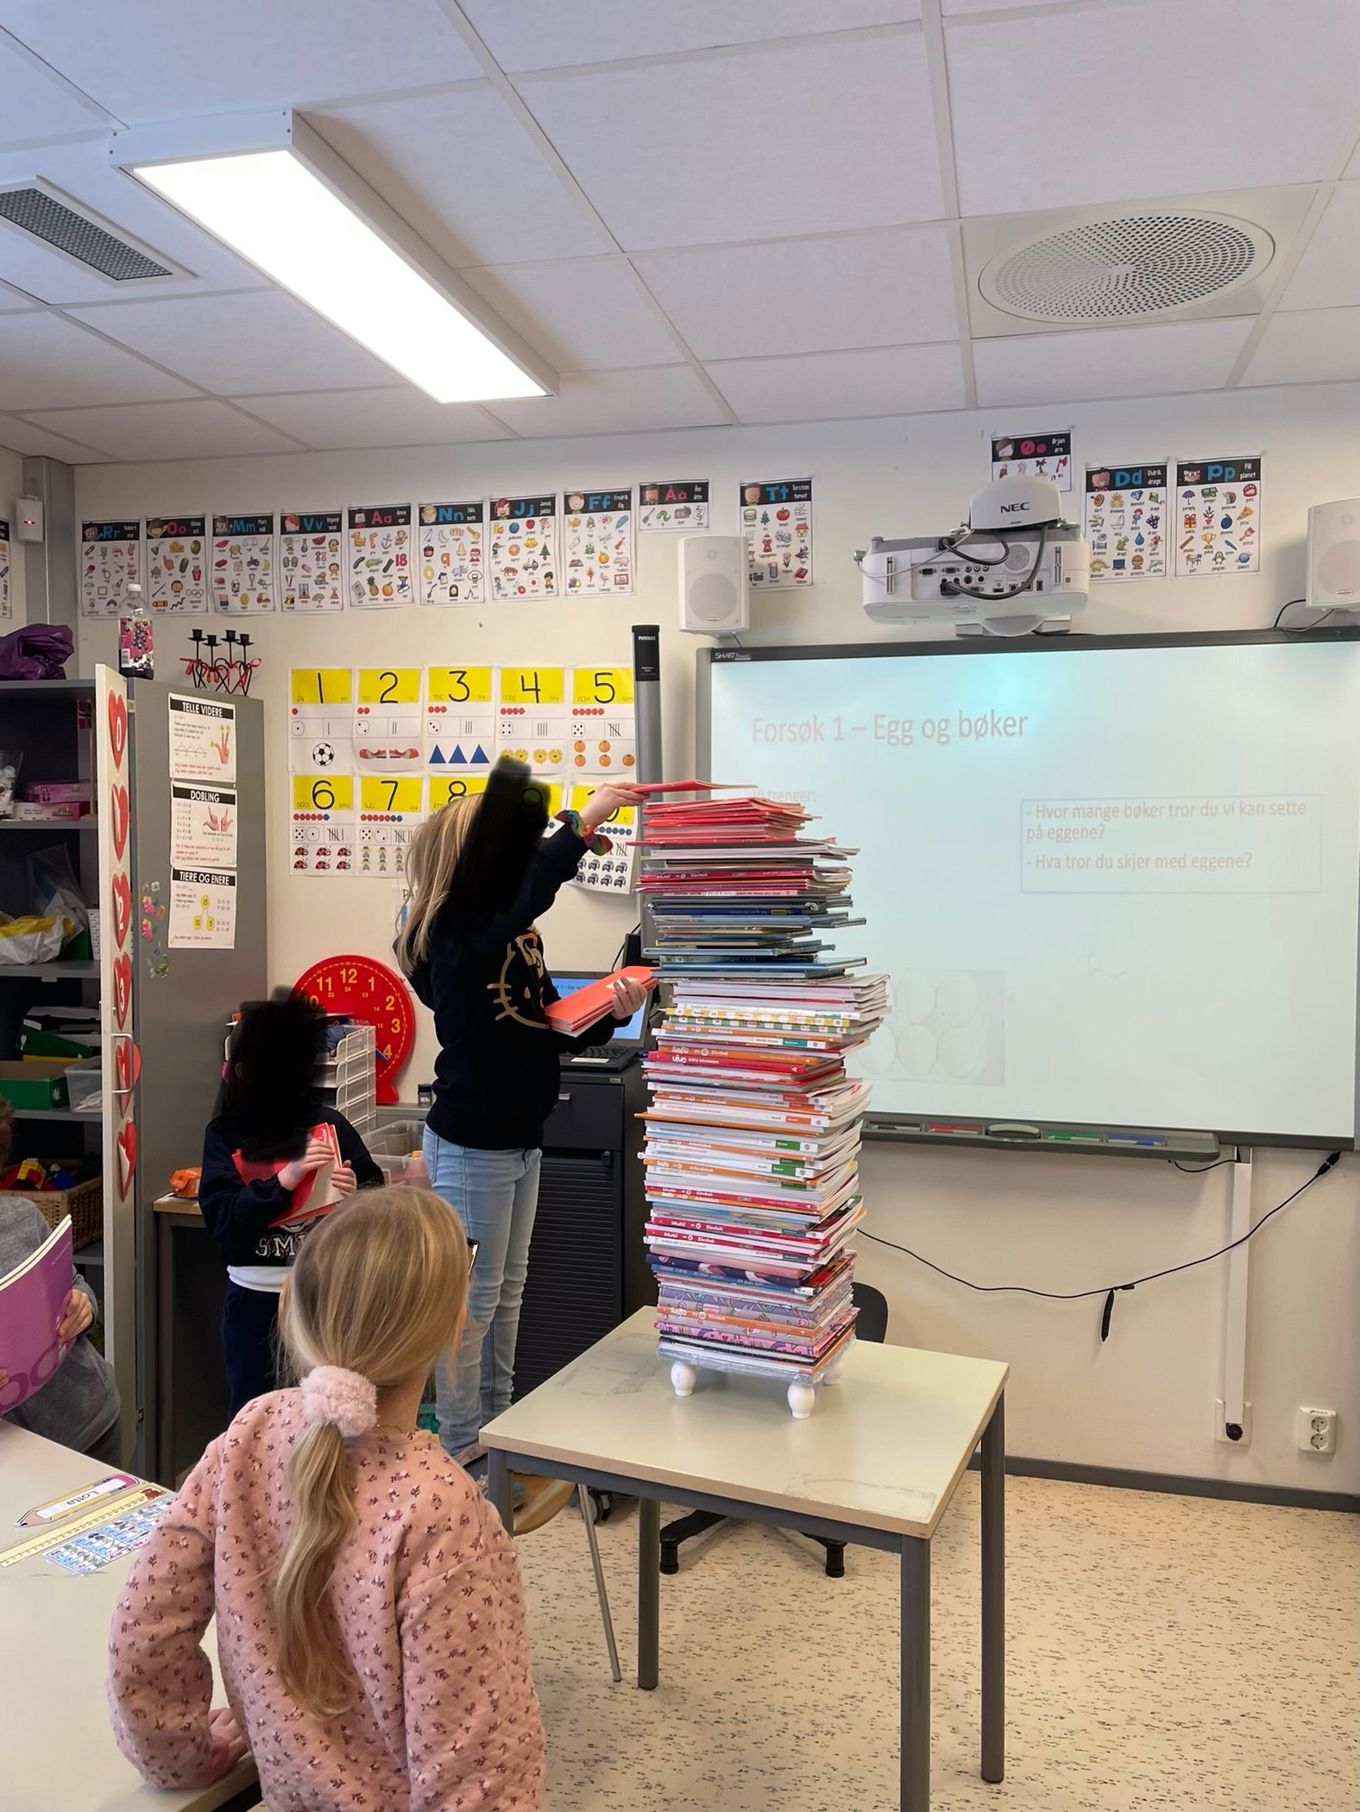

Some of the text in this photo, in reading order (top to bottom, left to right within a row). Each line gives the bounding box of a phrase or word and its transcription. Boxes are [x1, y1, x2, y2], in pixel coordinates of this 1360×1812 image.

[1115, 470, 1142, 487] Dd
[1207, 464, 1236, 481] Pp
[766, 485, 789, 500] Tt
[513, 501, 535, 517] Jj
[588, 496, 611, 511] Ff
[1000, 502, 1031, 513] NEC
[371, 511, 393, 525] Aa
[439, 507, 464, 521] Nn
[103, 525, 120, 537] Rr
[167, 521, 187, 535] Oo
[232, 519, 256, 533] Mm
[303, 518, 323, 531] Vv
[318, 672, 324, 704] 1
[379, 671, 399, 704] 2
[448, 671, 470, 702] 3
[521, 671, 542, 704] 4
[594, 671, 616, 704] 5
[182, 702, 223, 718] TELLE VIDERE
[752, 713, 825, 744] Forsøk
[832, 717, 845, 741] 1
[873, 713, 914, 746] Egg
[921, 719, 950, 745] og
[958, 709, 1029, 740] bøker
[190, 789, 220, 803] DOBLING
[312, 780, 335, 810] 6
[380, 780, 399, 811] 7
[1035, 803, 1069, 819] Hvor
[1072, 806, 1119, 823] mange
[1124, 802, 1164, 819] bøker
[1168, 803, 1196, 818] tror
[1200, 801, 1218, 817] du
[1223, 801, 1235, 816] vi
[1239, 800, 1265, 816] kan
[1269, 801, 1307, 816] sette
[1027, 824, 1106, 844] på eggene?
[1035, 853, 1062, 869] Hva
[1065, 854, 1092, 869] tror
[1095, 852, 1113, 869] du
[1116, 853, 1151, 872] skjer
[1155, 852, 1187, 869] med
[1191, 852, 1253, 872] eggene?
[180, 871, 230, 886] TIERE OG ENERE
[316, 976, 333, 992] 11
[340, 968, 358, 984] 12
[368, 977, 375, 992] 1
[385, 995, 395, 1011] 2
[391, 1018, 401, 1034] 3
[383, 1044, 392, 1058] 4
[66, 1490, 100, 1507] Lotta
